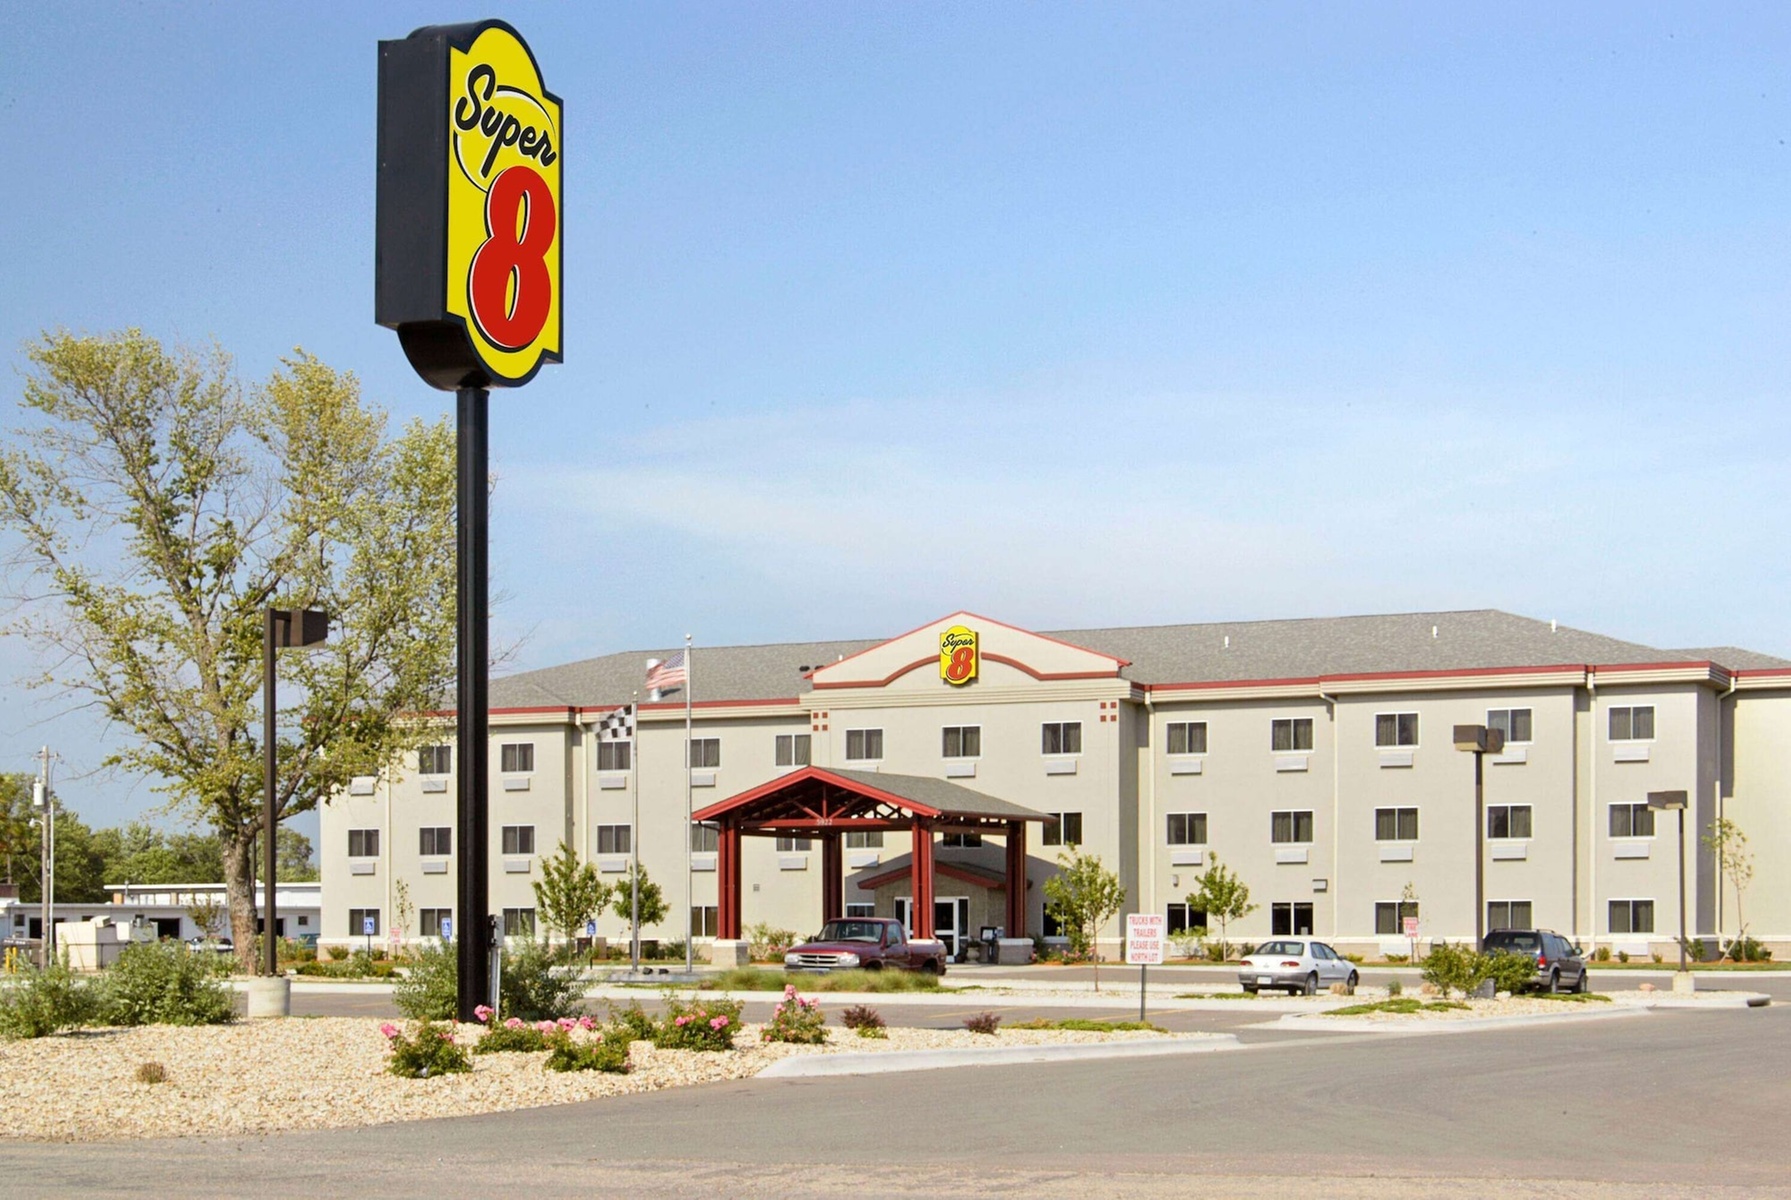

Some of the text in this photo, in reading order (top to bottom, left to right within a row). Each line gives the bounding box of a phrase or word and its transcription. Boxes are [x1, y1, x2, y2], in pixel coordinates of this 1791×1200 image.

[455, 63, 557, 178] Super
[466, 165, 556, 353] 8
[942, 633, 974, 653] Super
[946, 646, 974, 681] 8
[1129, 916, 1162, 925] TRUCKS WITH
[1133, 928, 1157, 937] TRAILERS
[1130, 940, 1159, 949] PLEASE USE
